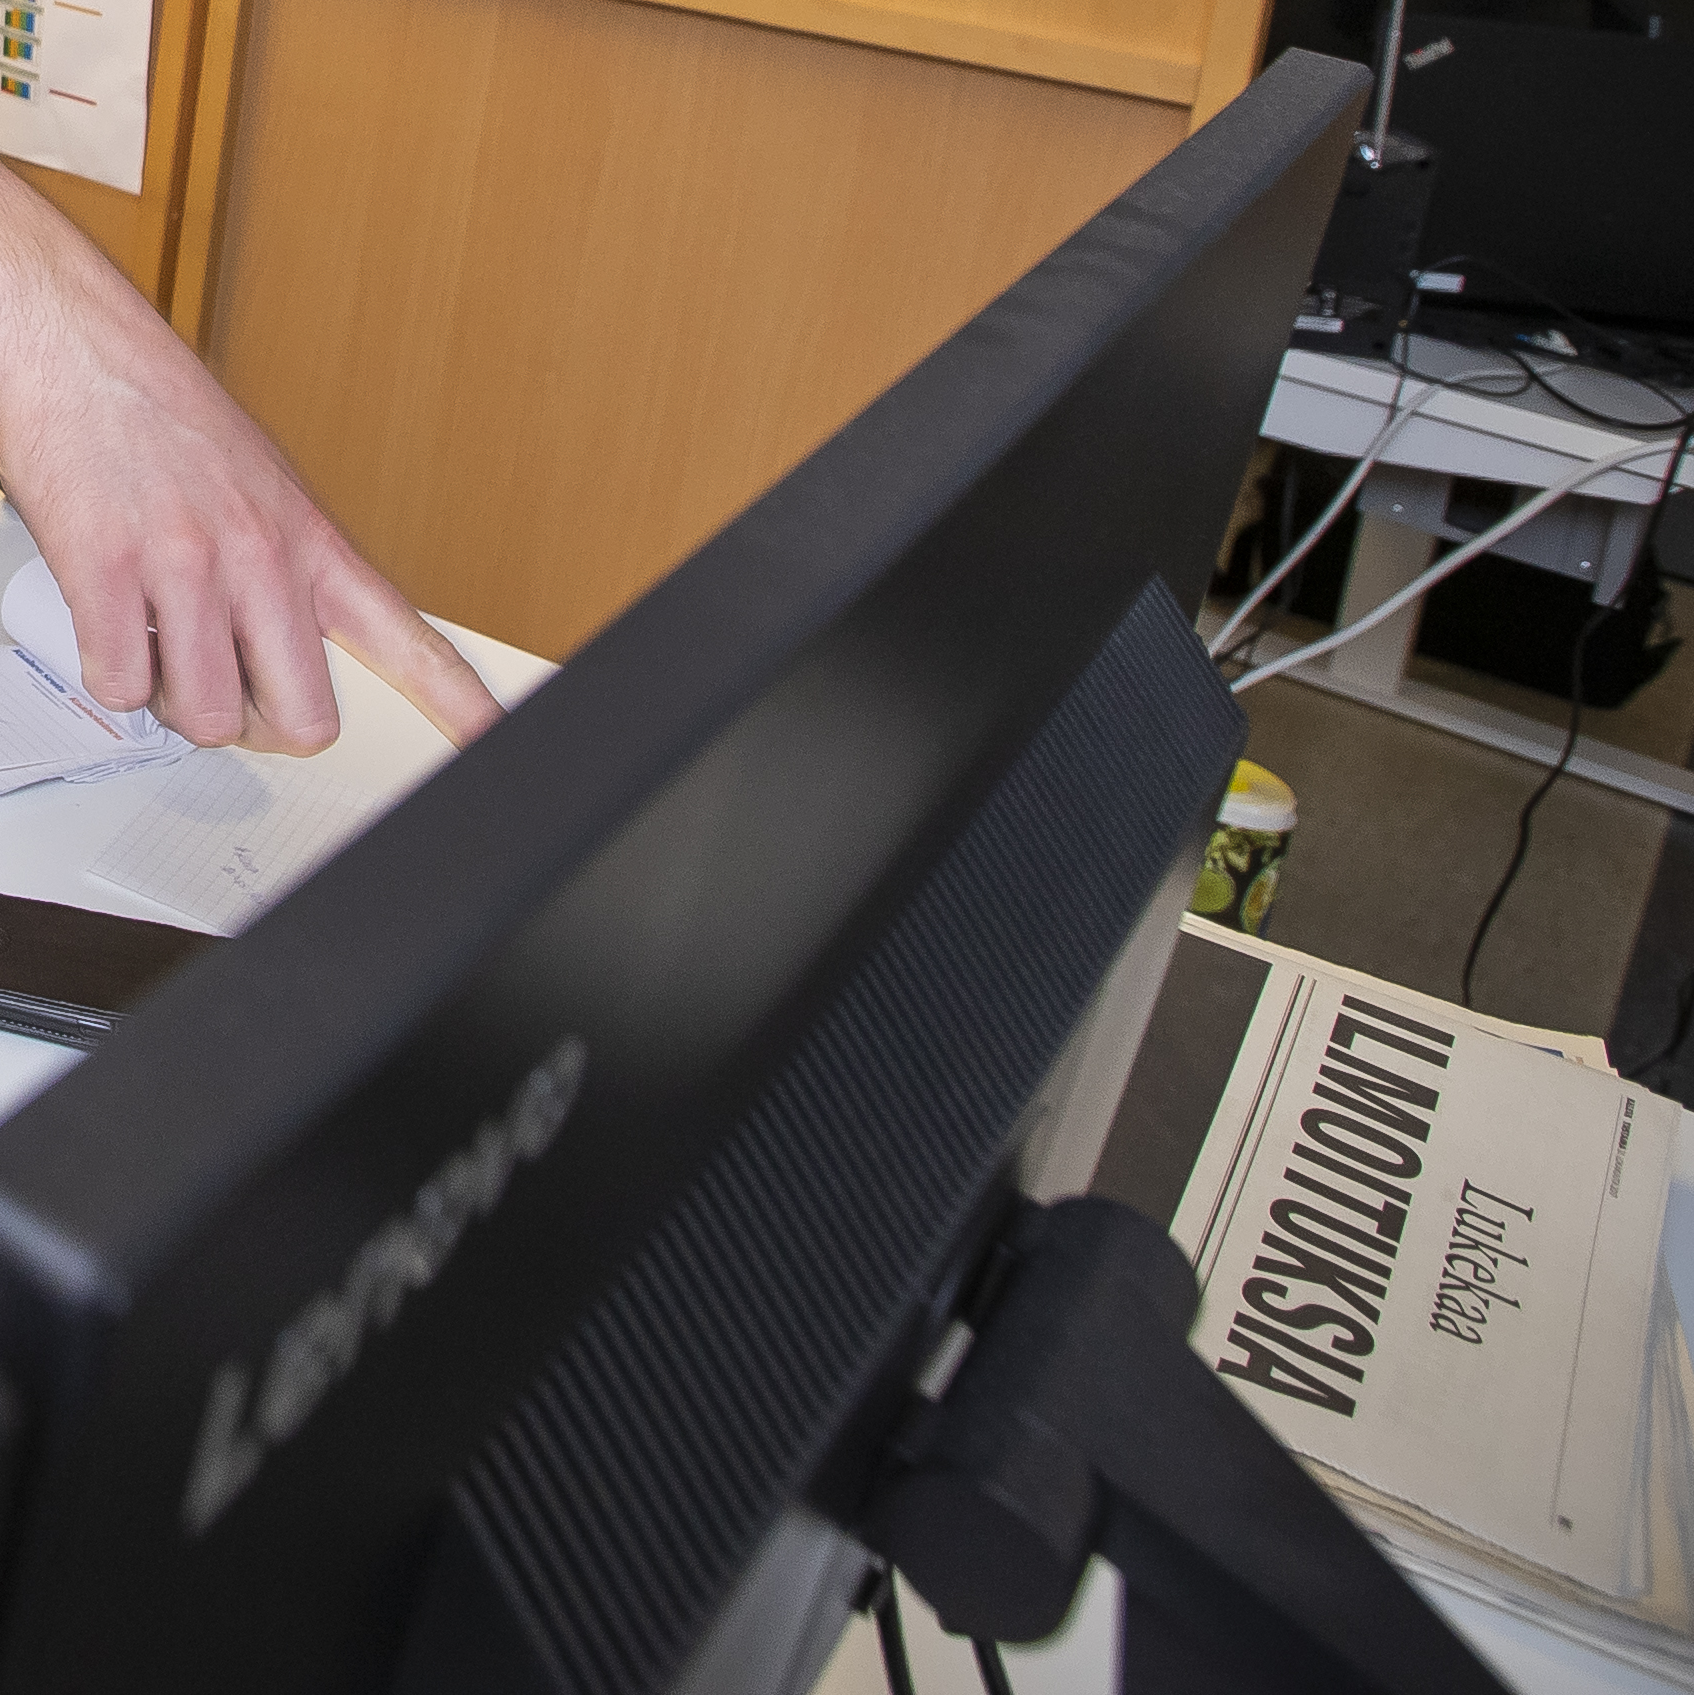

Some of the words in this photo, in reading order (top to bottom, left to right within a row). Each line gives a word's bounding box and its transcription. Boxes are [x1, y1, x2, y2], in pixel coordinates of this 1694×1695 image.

[184, 1034, 588, 1536] Lenovo
[1216, 994, 1455, 1418] ILMOITUKSIA
[1429, 1178, 1534, 1346] Lukekaa
